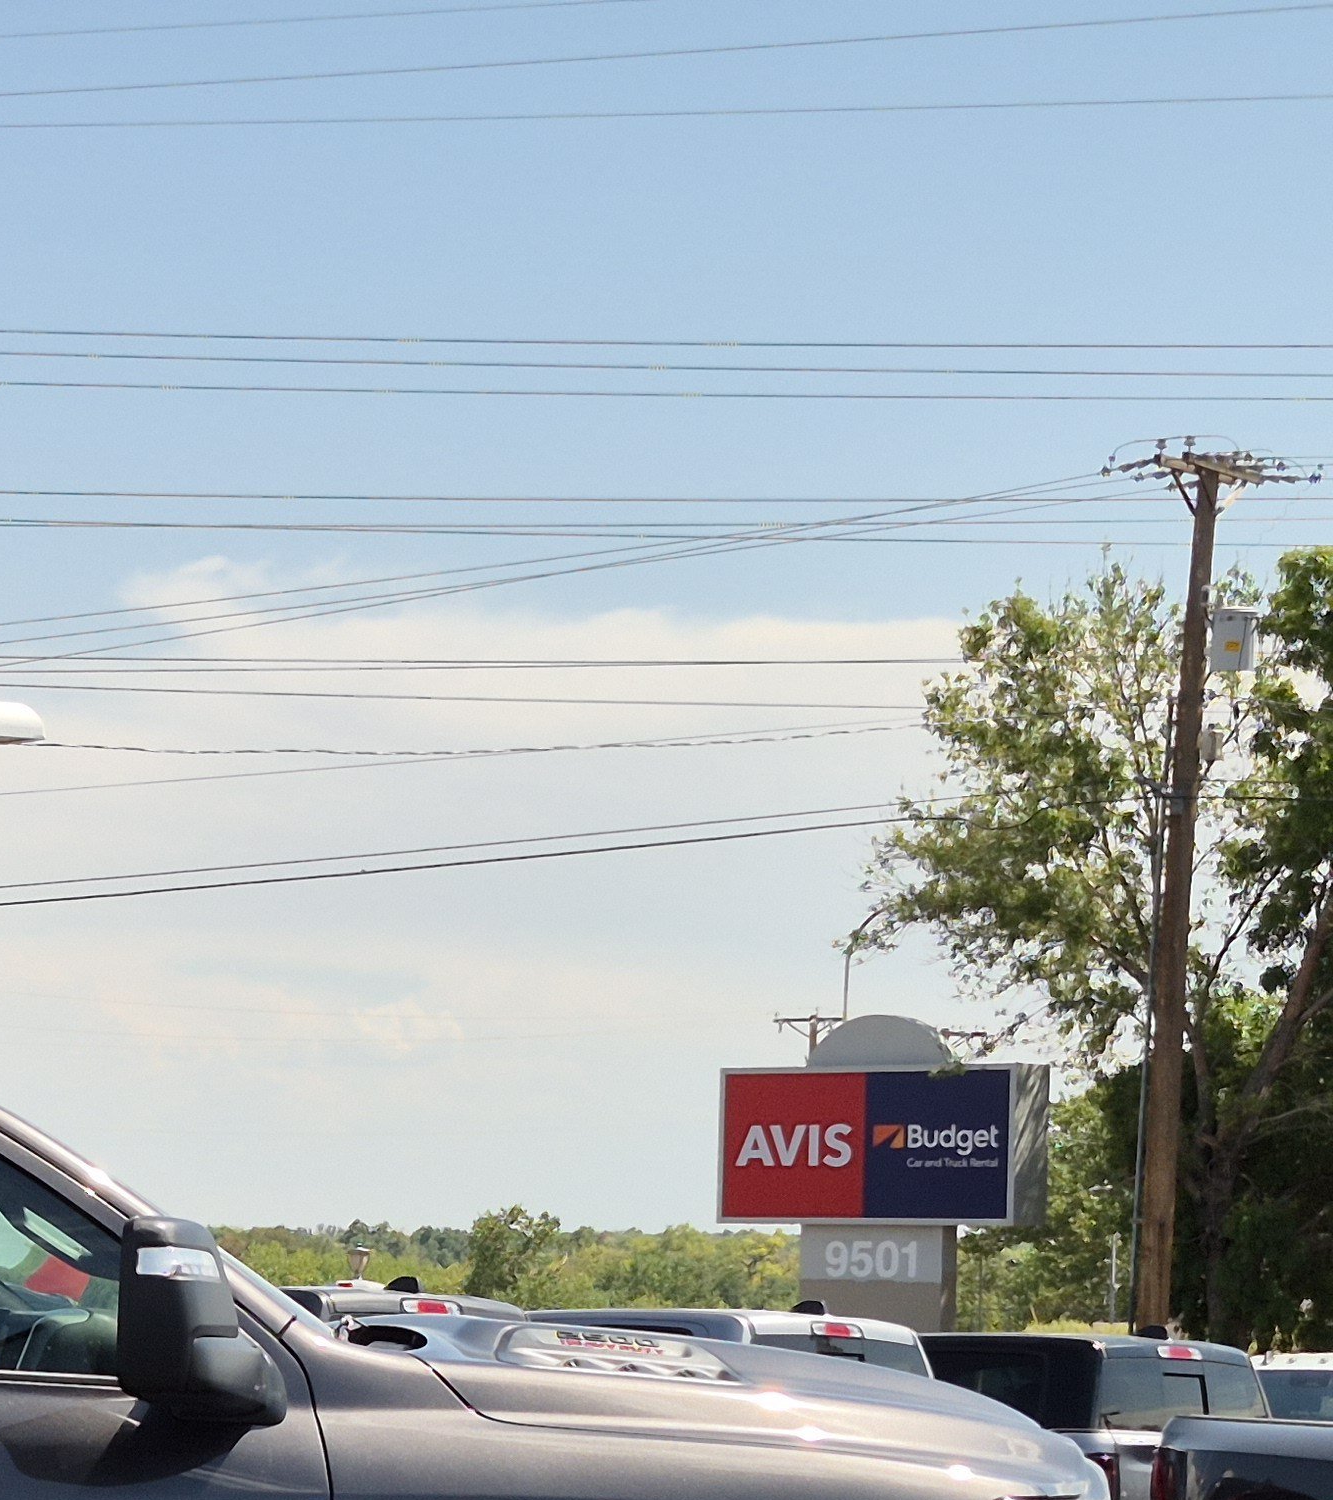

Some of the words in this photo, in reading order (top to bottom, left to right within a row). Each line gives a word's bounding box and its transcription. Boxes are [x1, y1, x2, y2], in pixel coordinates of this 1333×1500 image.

[735, 1124, 853, 1168] AVIS
[906, 1124, 1000, 1156] Budget
[825, 1240, 919, 1279] 9501
